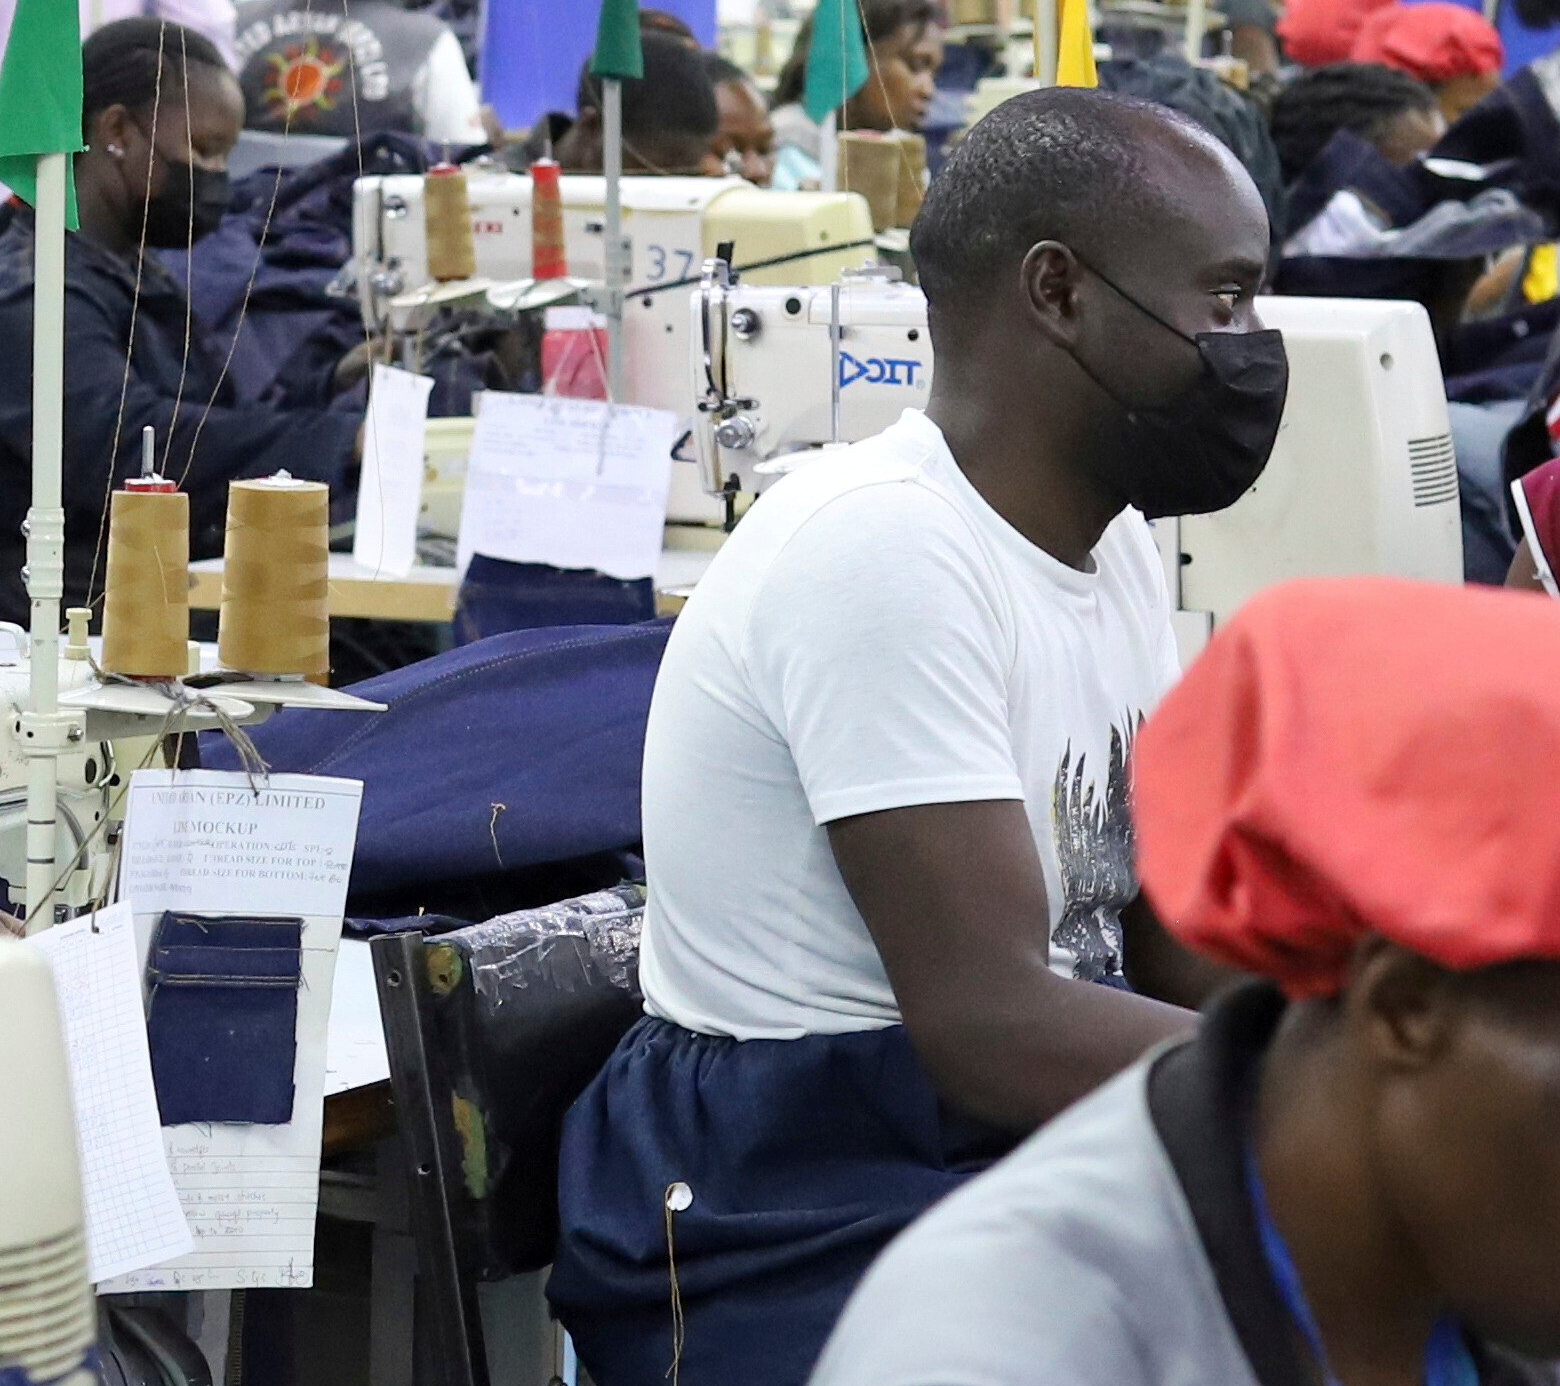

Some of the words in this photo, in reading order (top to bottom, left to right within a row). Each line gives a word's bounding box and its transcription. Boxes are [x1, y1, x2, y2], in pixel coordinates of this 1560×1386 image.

[646, 244, 695, 282] 37
[255, 795, 326, 810] LIMITED
[191, 821, 258, 836] MOCKUP
